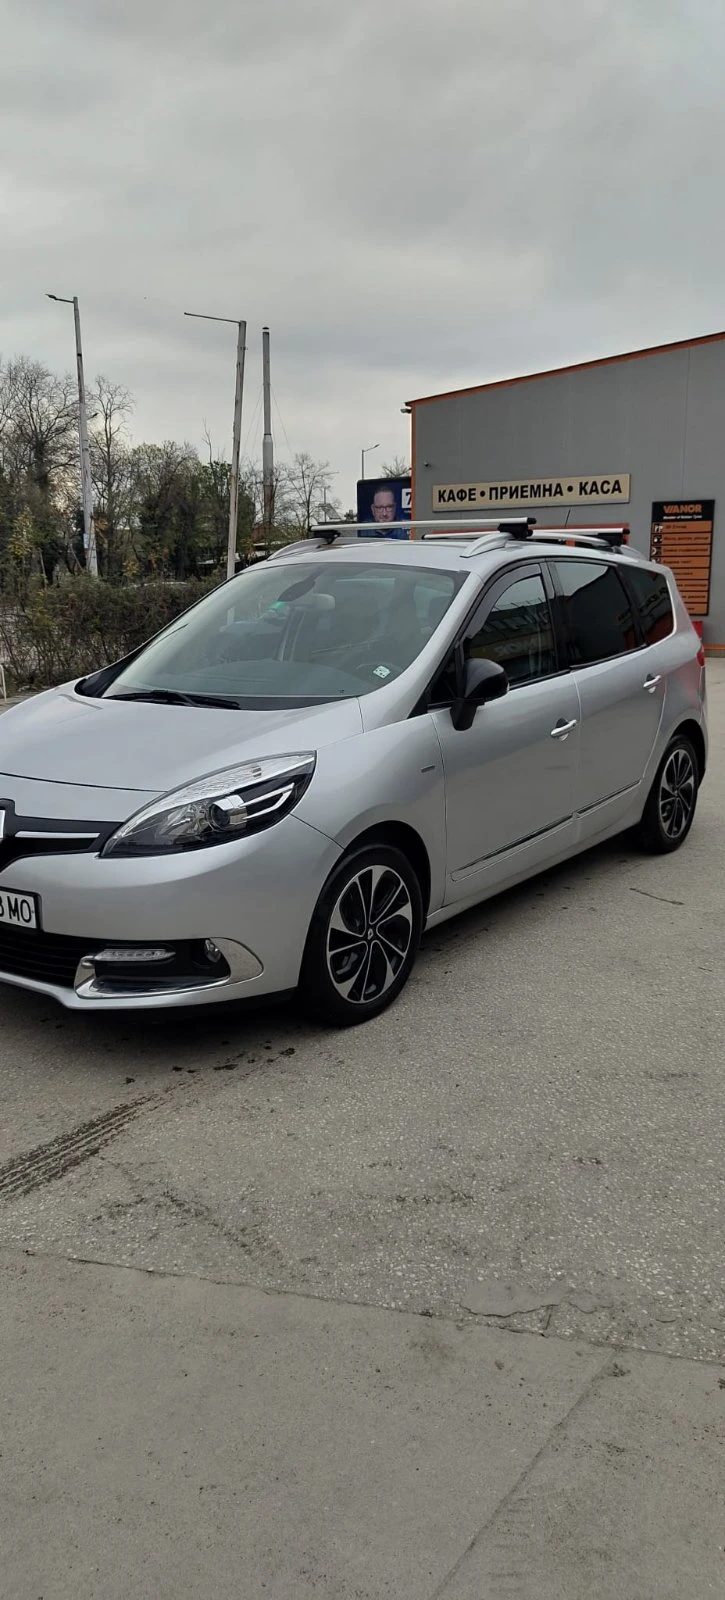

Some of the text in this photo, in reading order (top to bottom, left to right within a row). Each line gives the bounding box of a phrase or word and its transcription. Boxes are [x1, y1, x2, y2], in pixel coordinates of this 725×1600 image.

[438, 479, 622, 503] КАФЕ ПРИЕМНА КАСА
